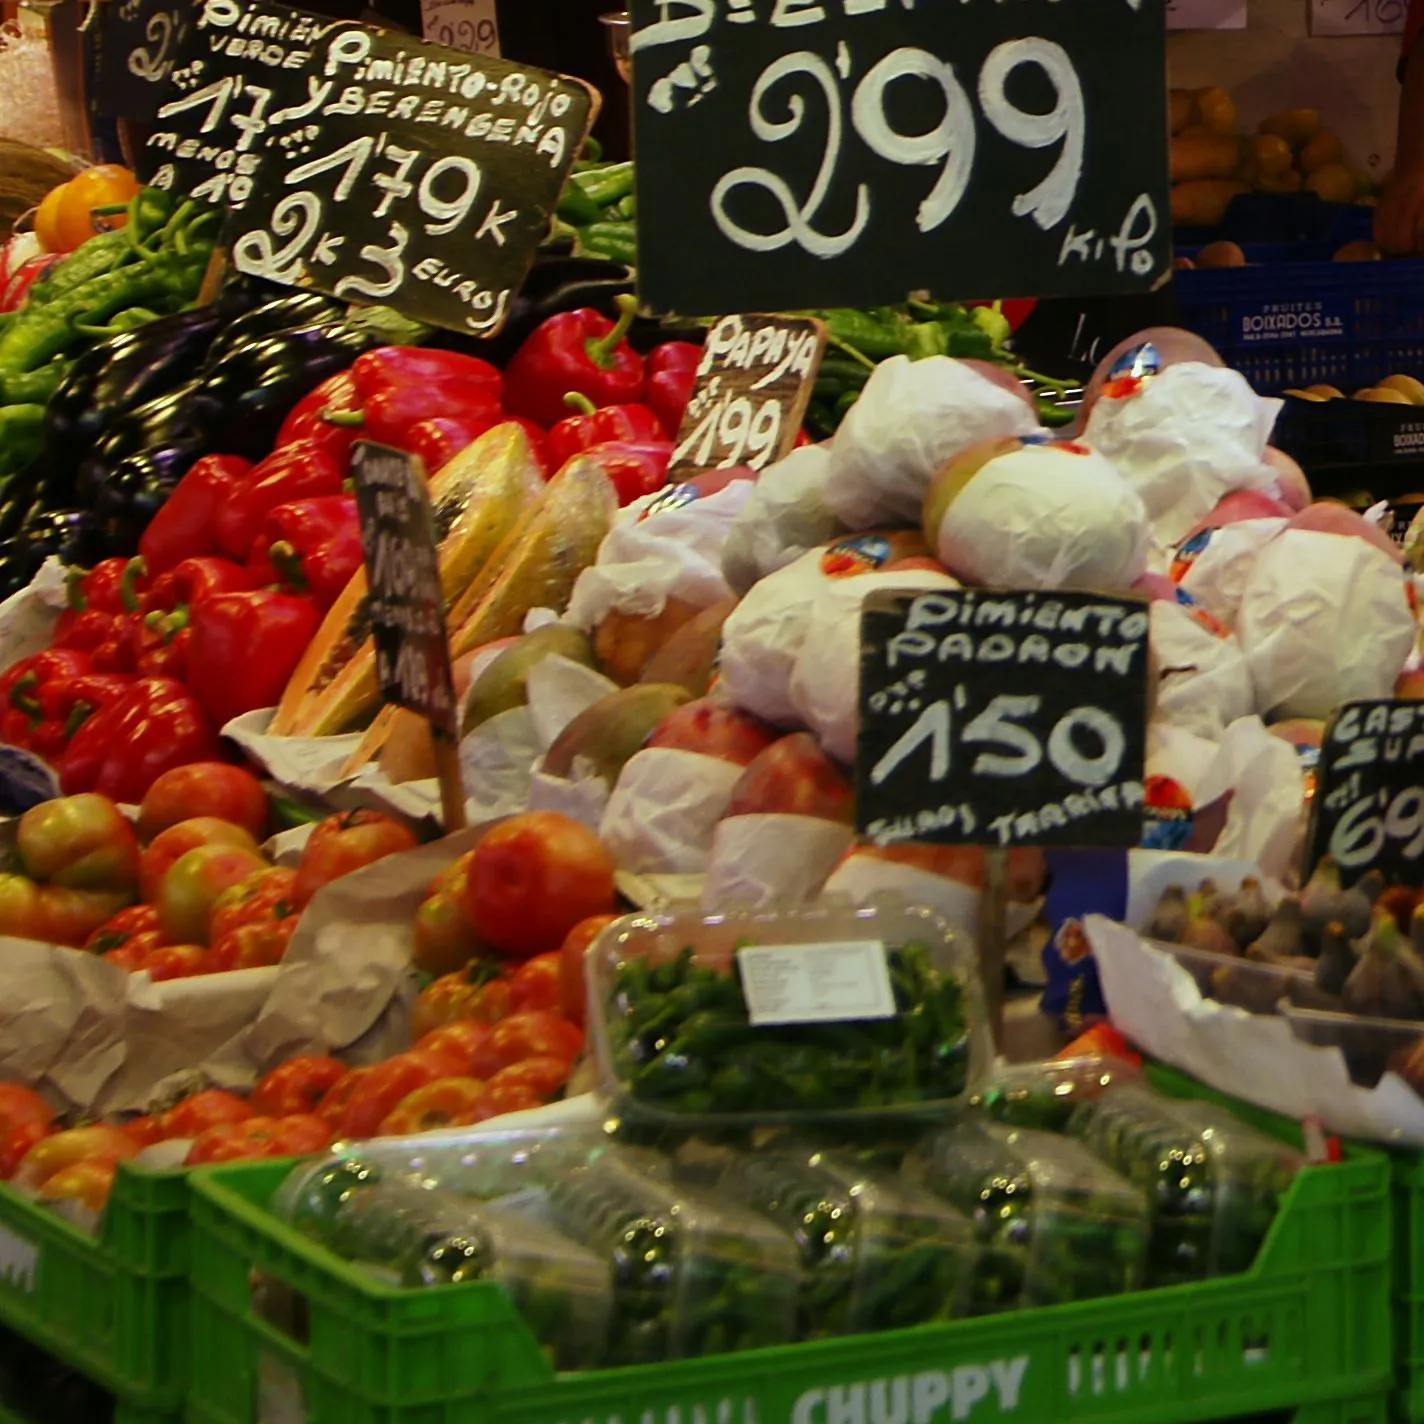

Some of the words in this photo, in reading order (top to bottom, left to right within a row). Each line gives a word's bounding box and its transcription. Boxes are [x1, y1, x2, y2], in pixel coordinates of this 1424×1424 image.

[710, 36, 1087, 260] 2'99
[332, 221, 410, 299] 3
[1241, 311, 1322, 333] BOIXADOS
[886, 630, 1142, 676] PADRON
[869, 682, 1127, 788] 1'50
[792, 1356, 1031, 1424] CHUPPY
